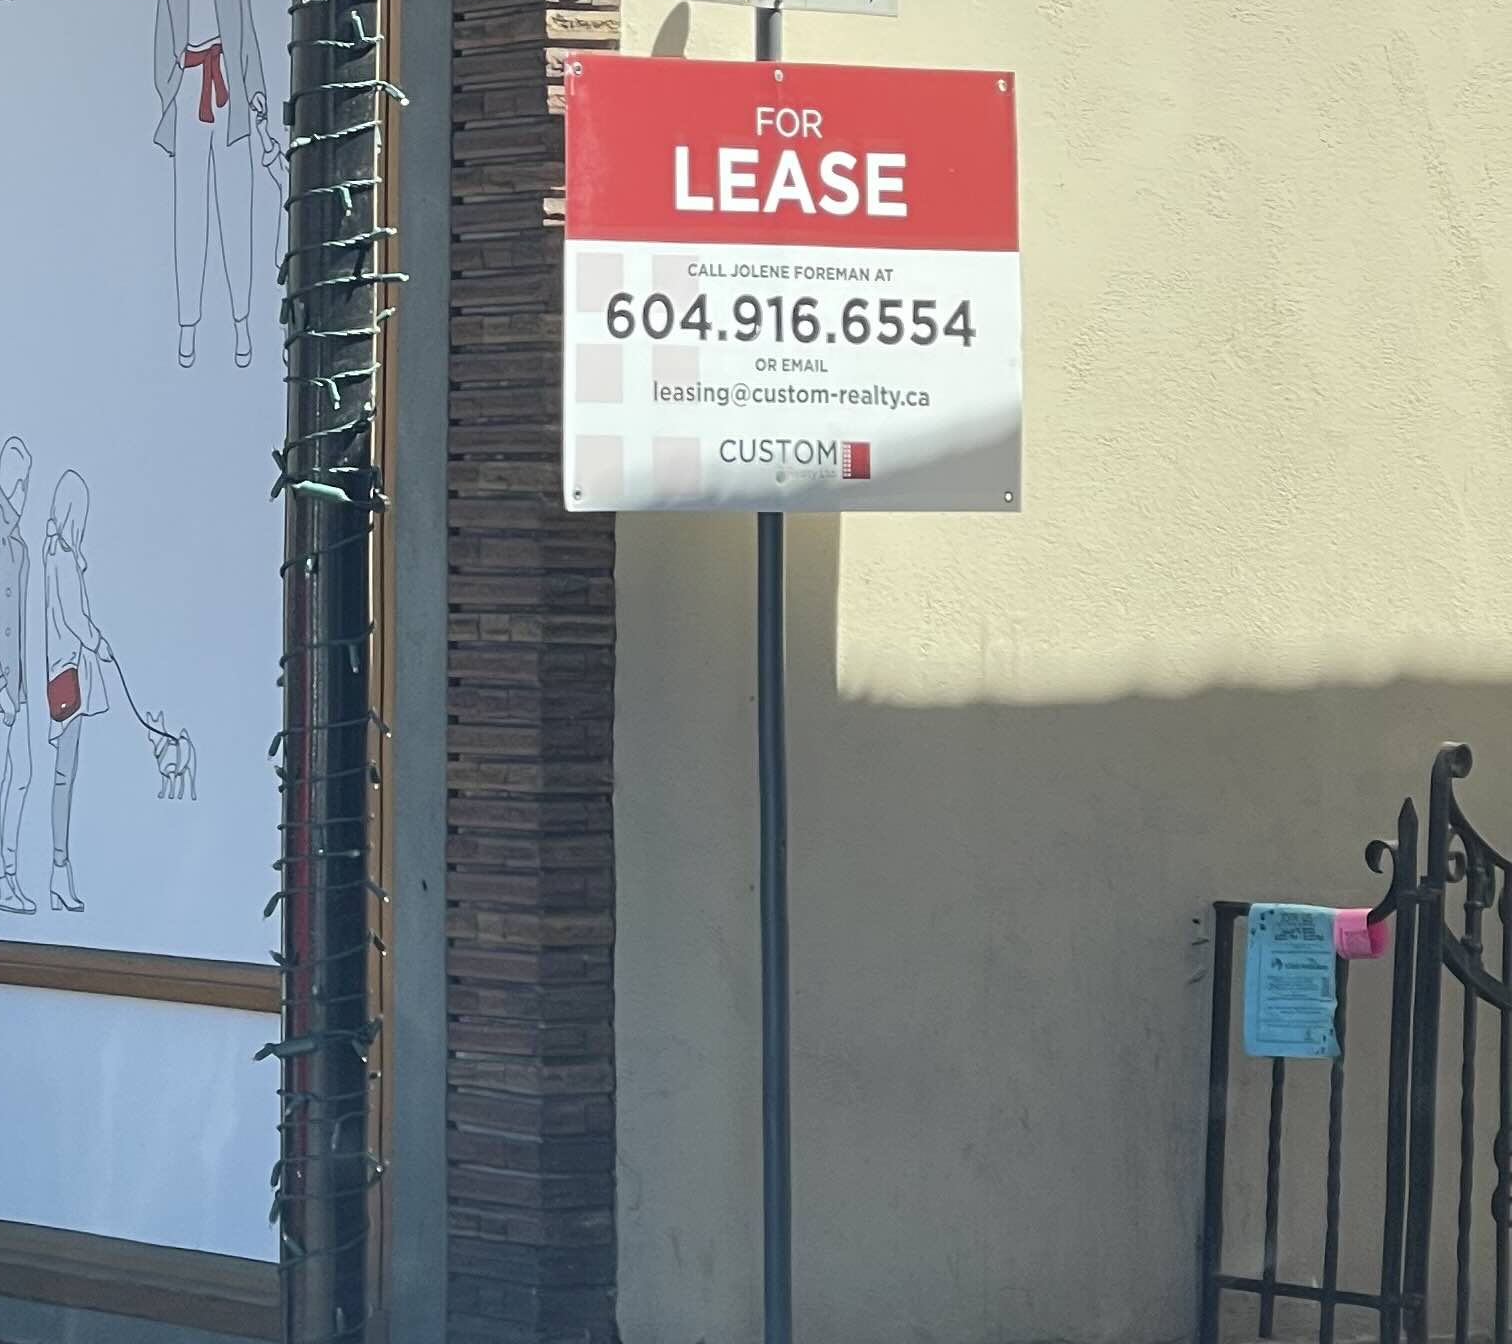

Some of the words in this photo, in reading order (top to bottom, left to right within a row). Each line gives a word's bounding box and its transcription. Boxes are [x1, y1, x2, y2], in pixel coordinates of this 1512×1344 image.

[755, 106, 824, 139] FOR
[674, 146, 908, 218] LEASE
[687, 262, 727, 278] CALL
[730, 264, 790, 280] JOLENE
[793, 266, 871, 282] FOREMAN
[873, 267, 894, 283] AT
[606, 291, 977, 348] 604.916.6554
[755, 358, 778, 373] OR
[781, 358, 829, 373] EMAIL
[652, 381, 931, 409] leasing@custom-realty.ca
[719, 439, 838, 465] CUSTOM
